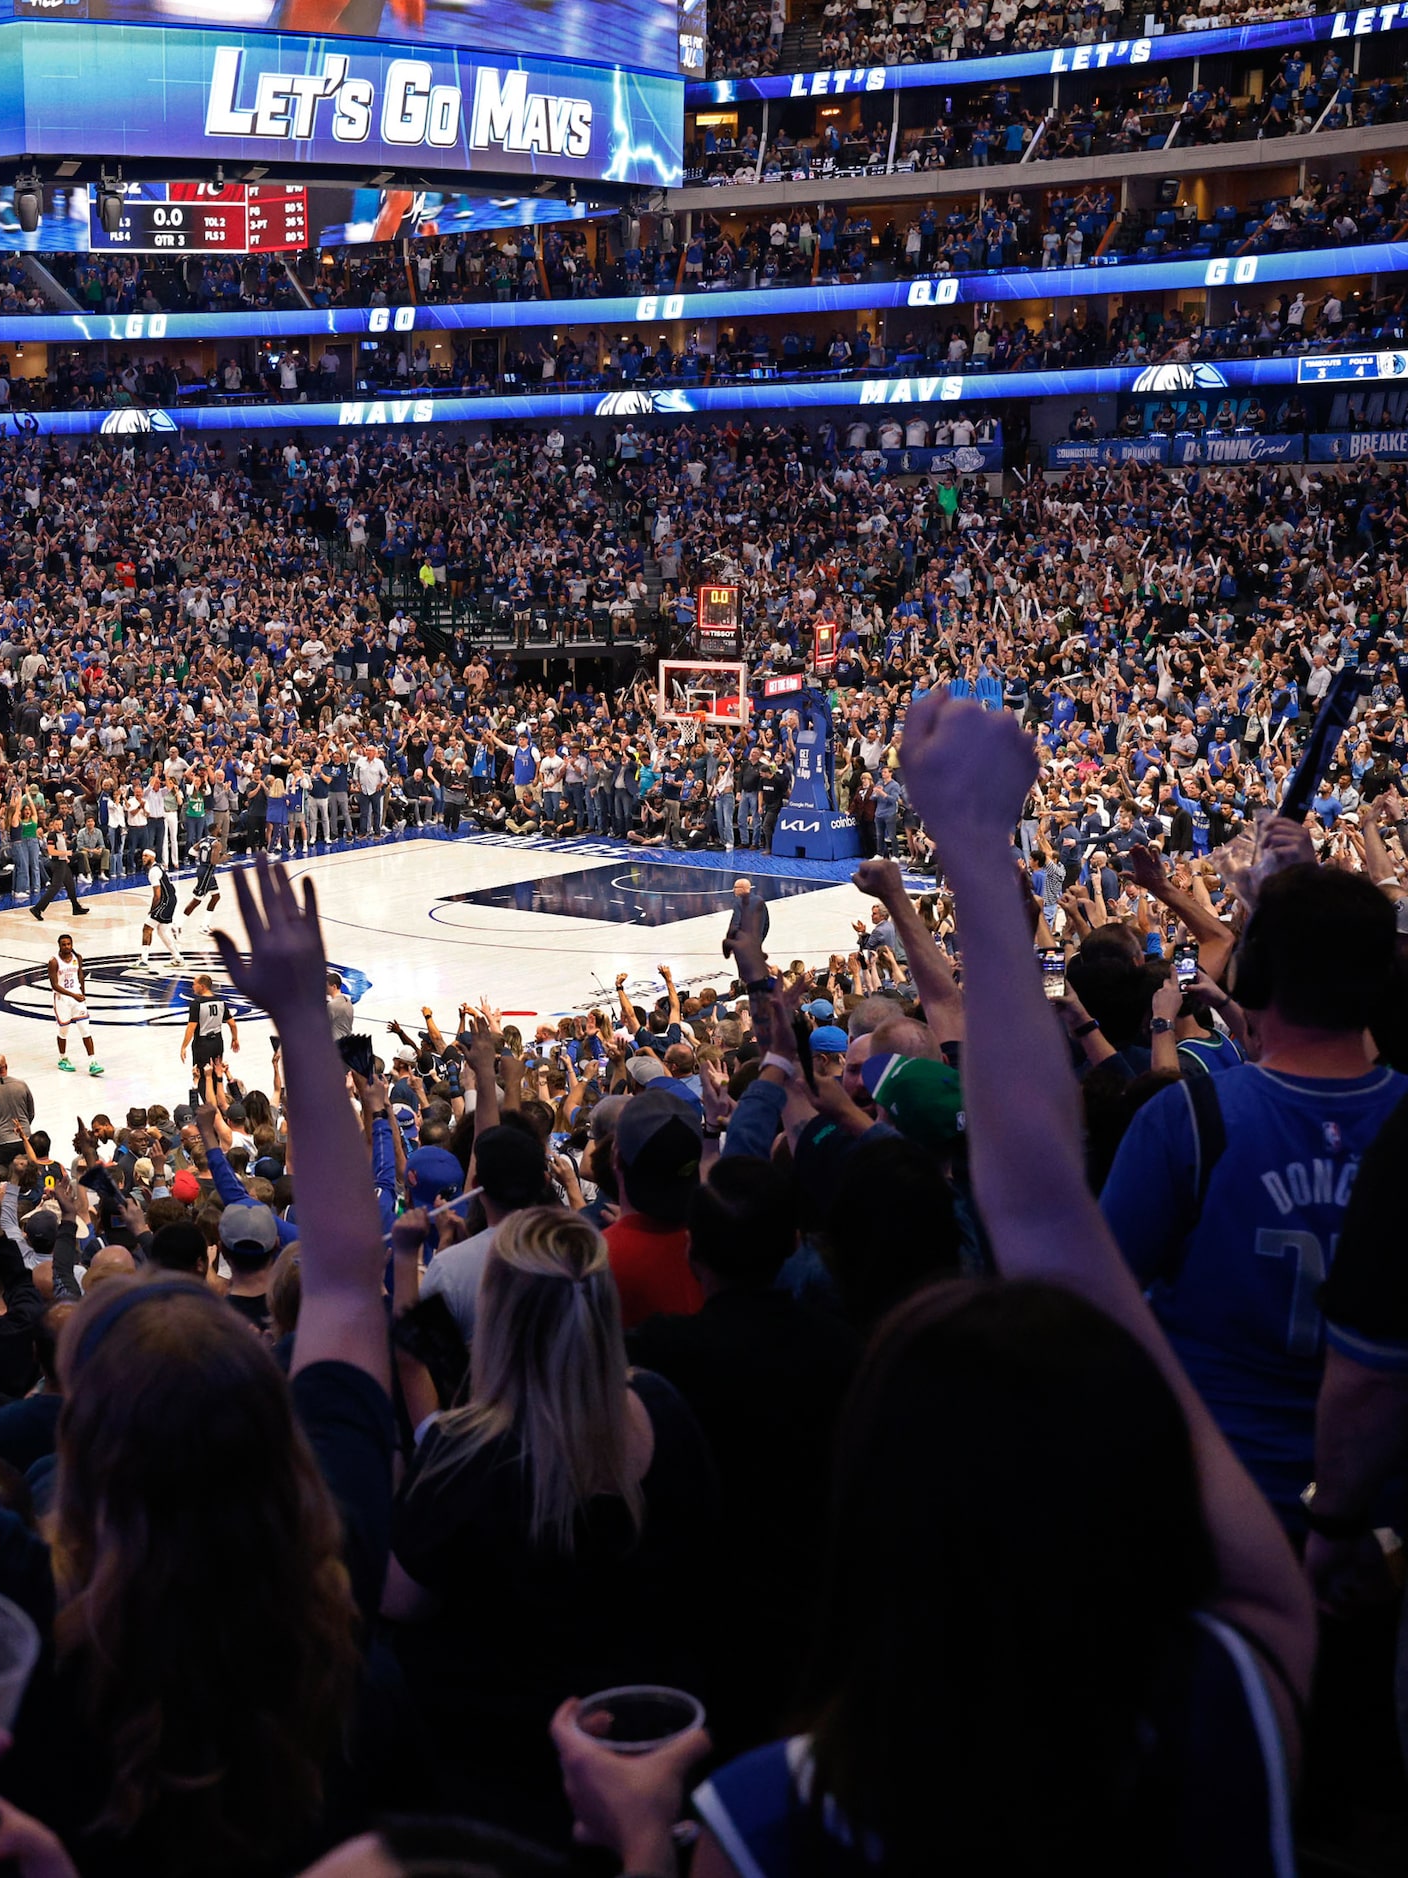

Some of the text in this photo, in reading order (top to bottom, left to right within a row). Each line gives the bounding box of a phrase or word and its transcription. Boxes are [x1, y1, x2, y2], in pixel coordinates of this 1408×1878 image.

[1052, 39, 1150, 72] LET'S
[791, 68, 885, 96] LET'S
[205, 46, 592, 158] LET'S GO MAVS
[249, 187, 259, 196] FT
[153, 208, 184, 226] 0.0
[250, 207, 260, 216] FG
[204, 218, 226, 227] TOL 2
[250, 220, 268, 230] 3-PT
[110, 232, 131, 241] FLS 4
[155, 235, 185, 246] QTR 3
[205, 232, 226, 241] FLS 3
[250, 235, 260, 245] FT
[1206, 257, 1257, 284] GO
[908, 279, 958, 305] GO
[637, 295, 684, 319] GO
[126, 314, 166, 337] GO
[369, 308, 414, 331] GO
[1349, 356, 1374, 365] FOULS
[1318, 366, 1365, 378] 3 4
[860, 377, 962, 403] MAVS
[339, 400, 433, 424] MAVS
[1249, 438, 1291, 455] Crew
[711, 590, 728, 603] 0.0
[64, 979, 74, 988] 22
[208, 1004, 218, 1017] 10
